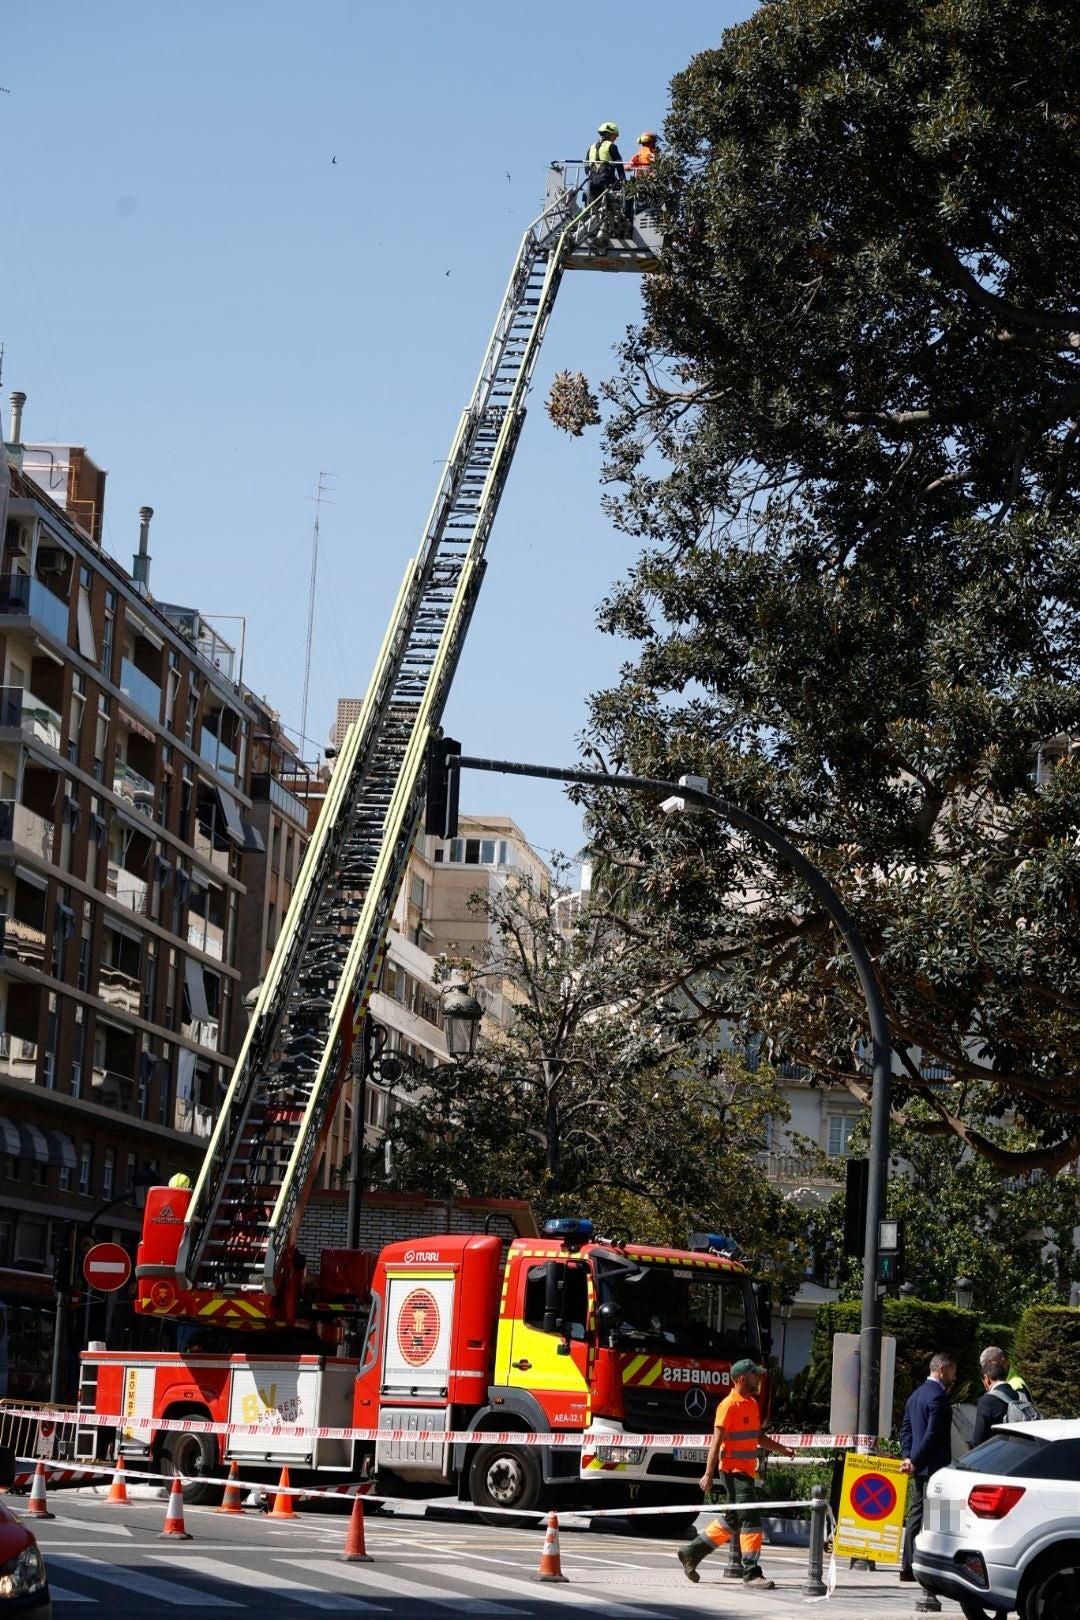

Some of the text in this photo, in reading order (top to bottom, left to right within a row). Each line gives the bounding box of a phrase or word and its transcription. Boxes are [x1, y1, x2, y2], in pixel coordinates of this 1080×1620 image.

[126, 1371, 136, 1440] BOMBES
[554, 1413, 584, 1423] AEA-32.1
[679, 1450, 697, 1461] 1406
